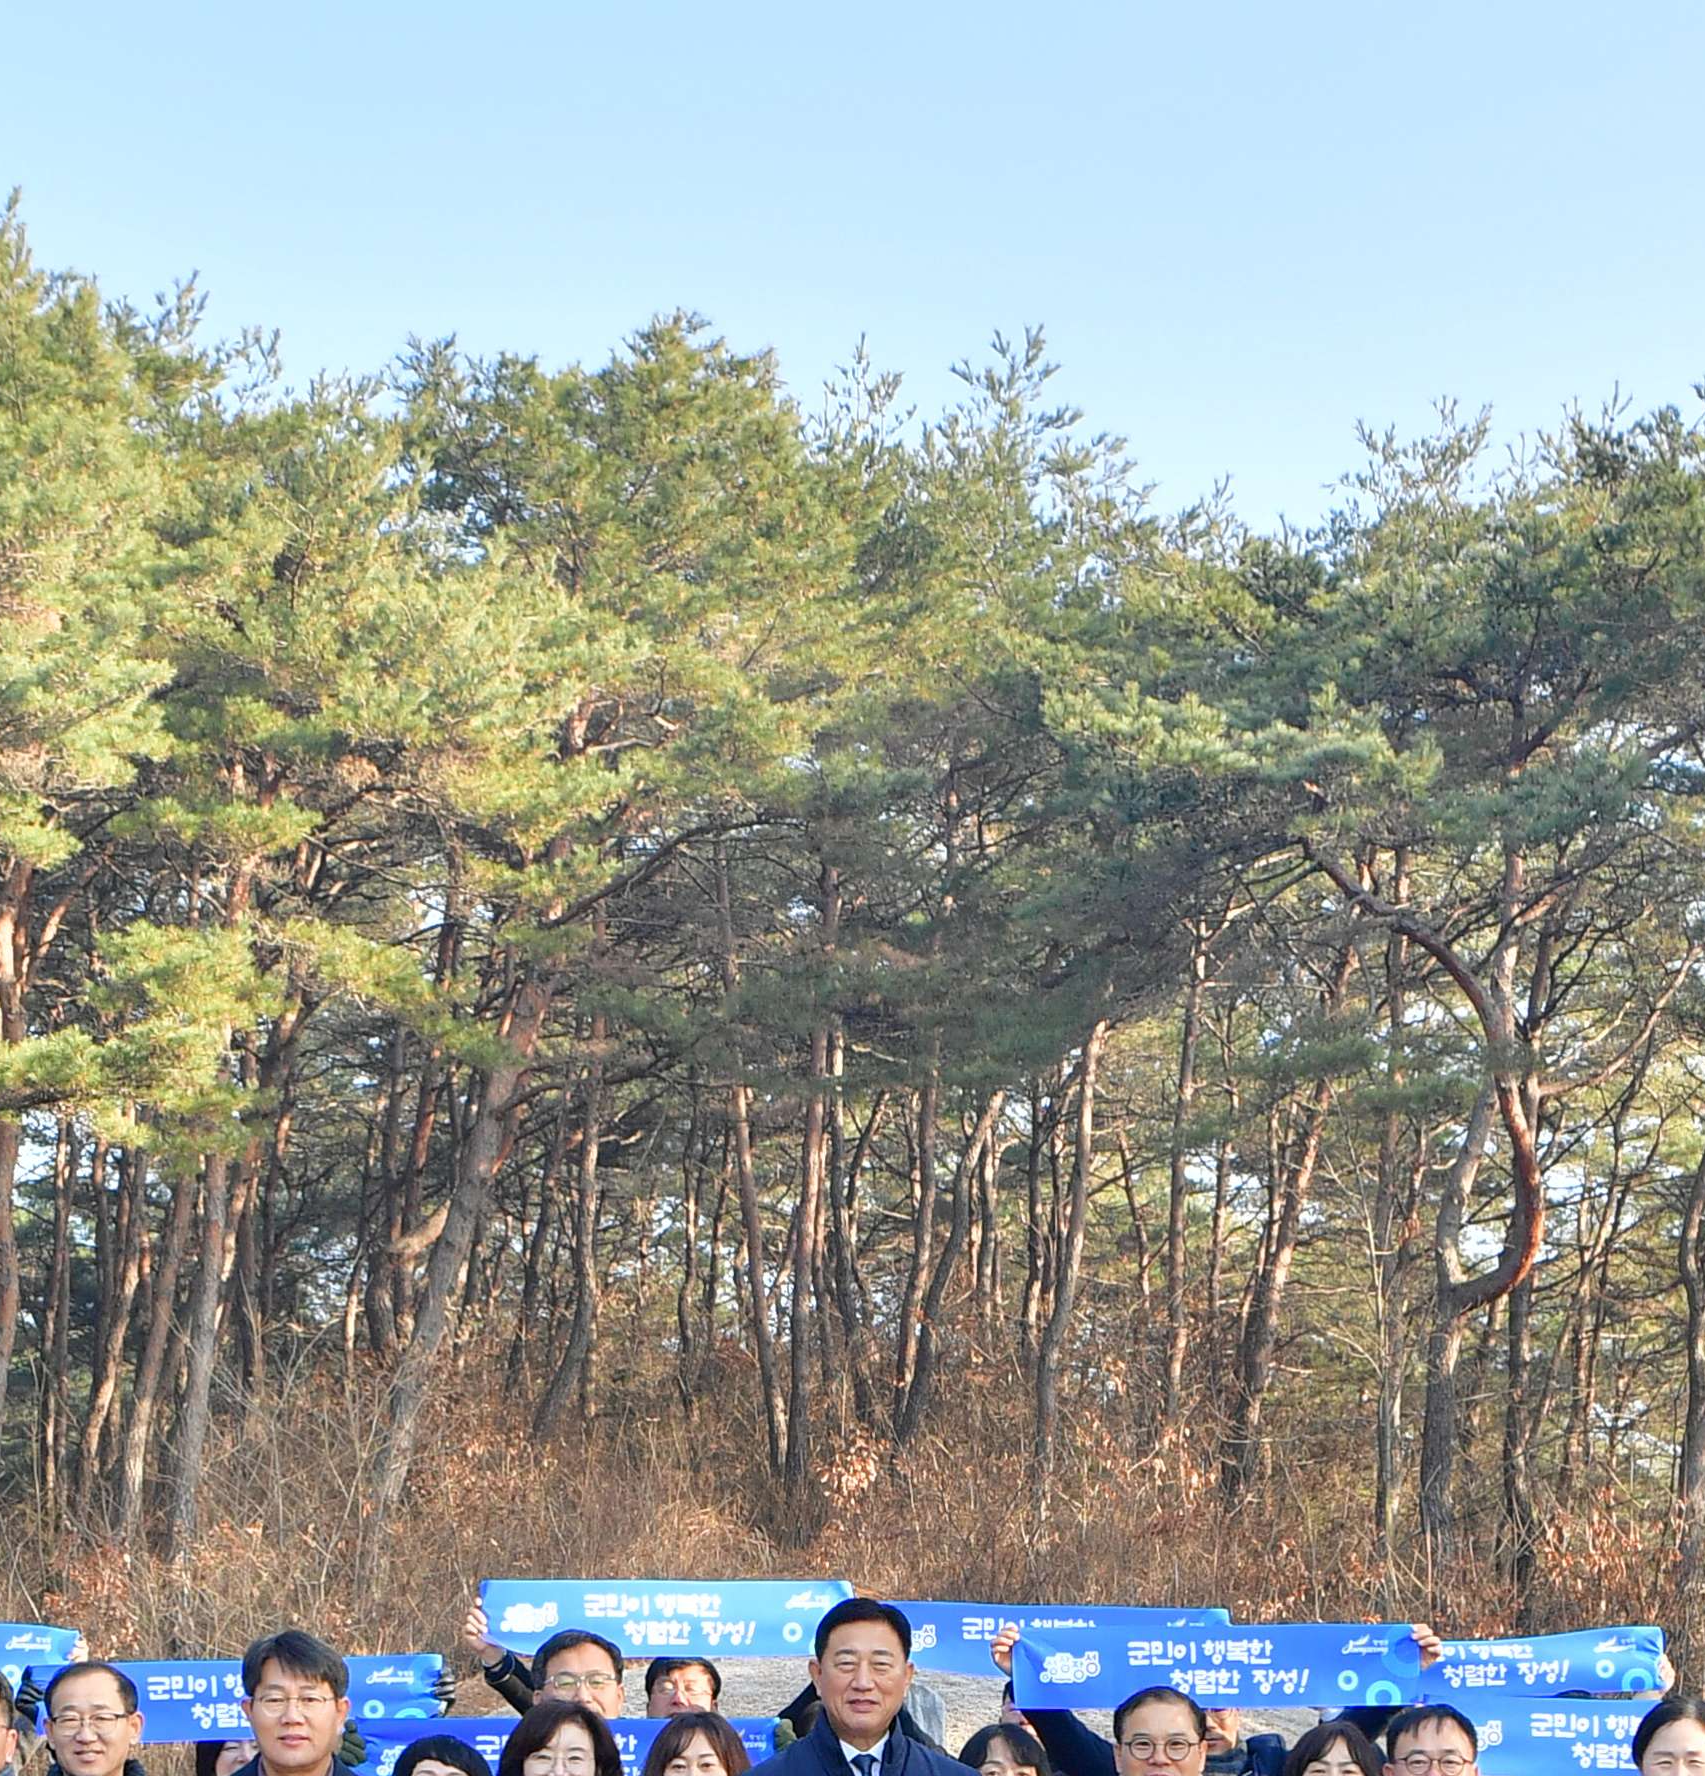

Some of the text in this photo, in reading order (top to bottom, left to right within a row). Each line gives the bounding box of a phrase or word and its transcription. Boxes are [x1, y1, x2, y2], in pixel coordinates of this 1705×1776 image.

[1127, 1640, 1273, 1667] 군민이 행복한
[1170, 1669, 1310, 1696] 청렴한 장성!
[1443, 1659, 1570, 1688] 청렴한 장성!
[147, 1675, 217, 1700] 군민이
[1530, 1713, 1599, 1738] 군민이
